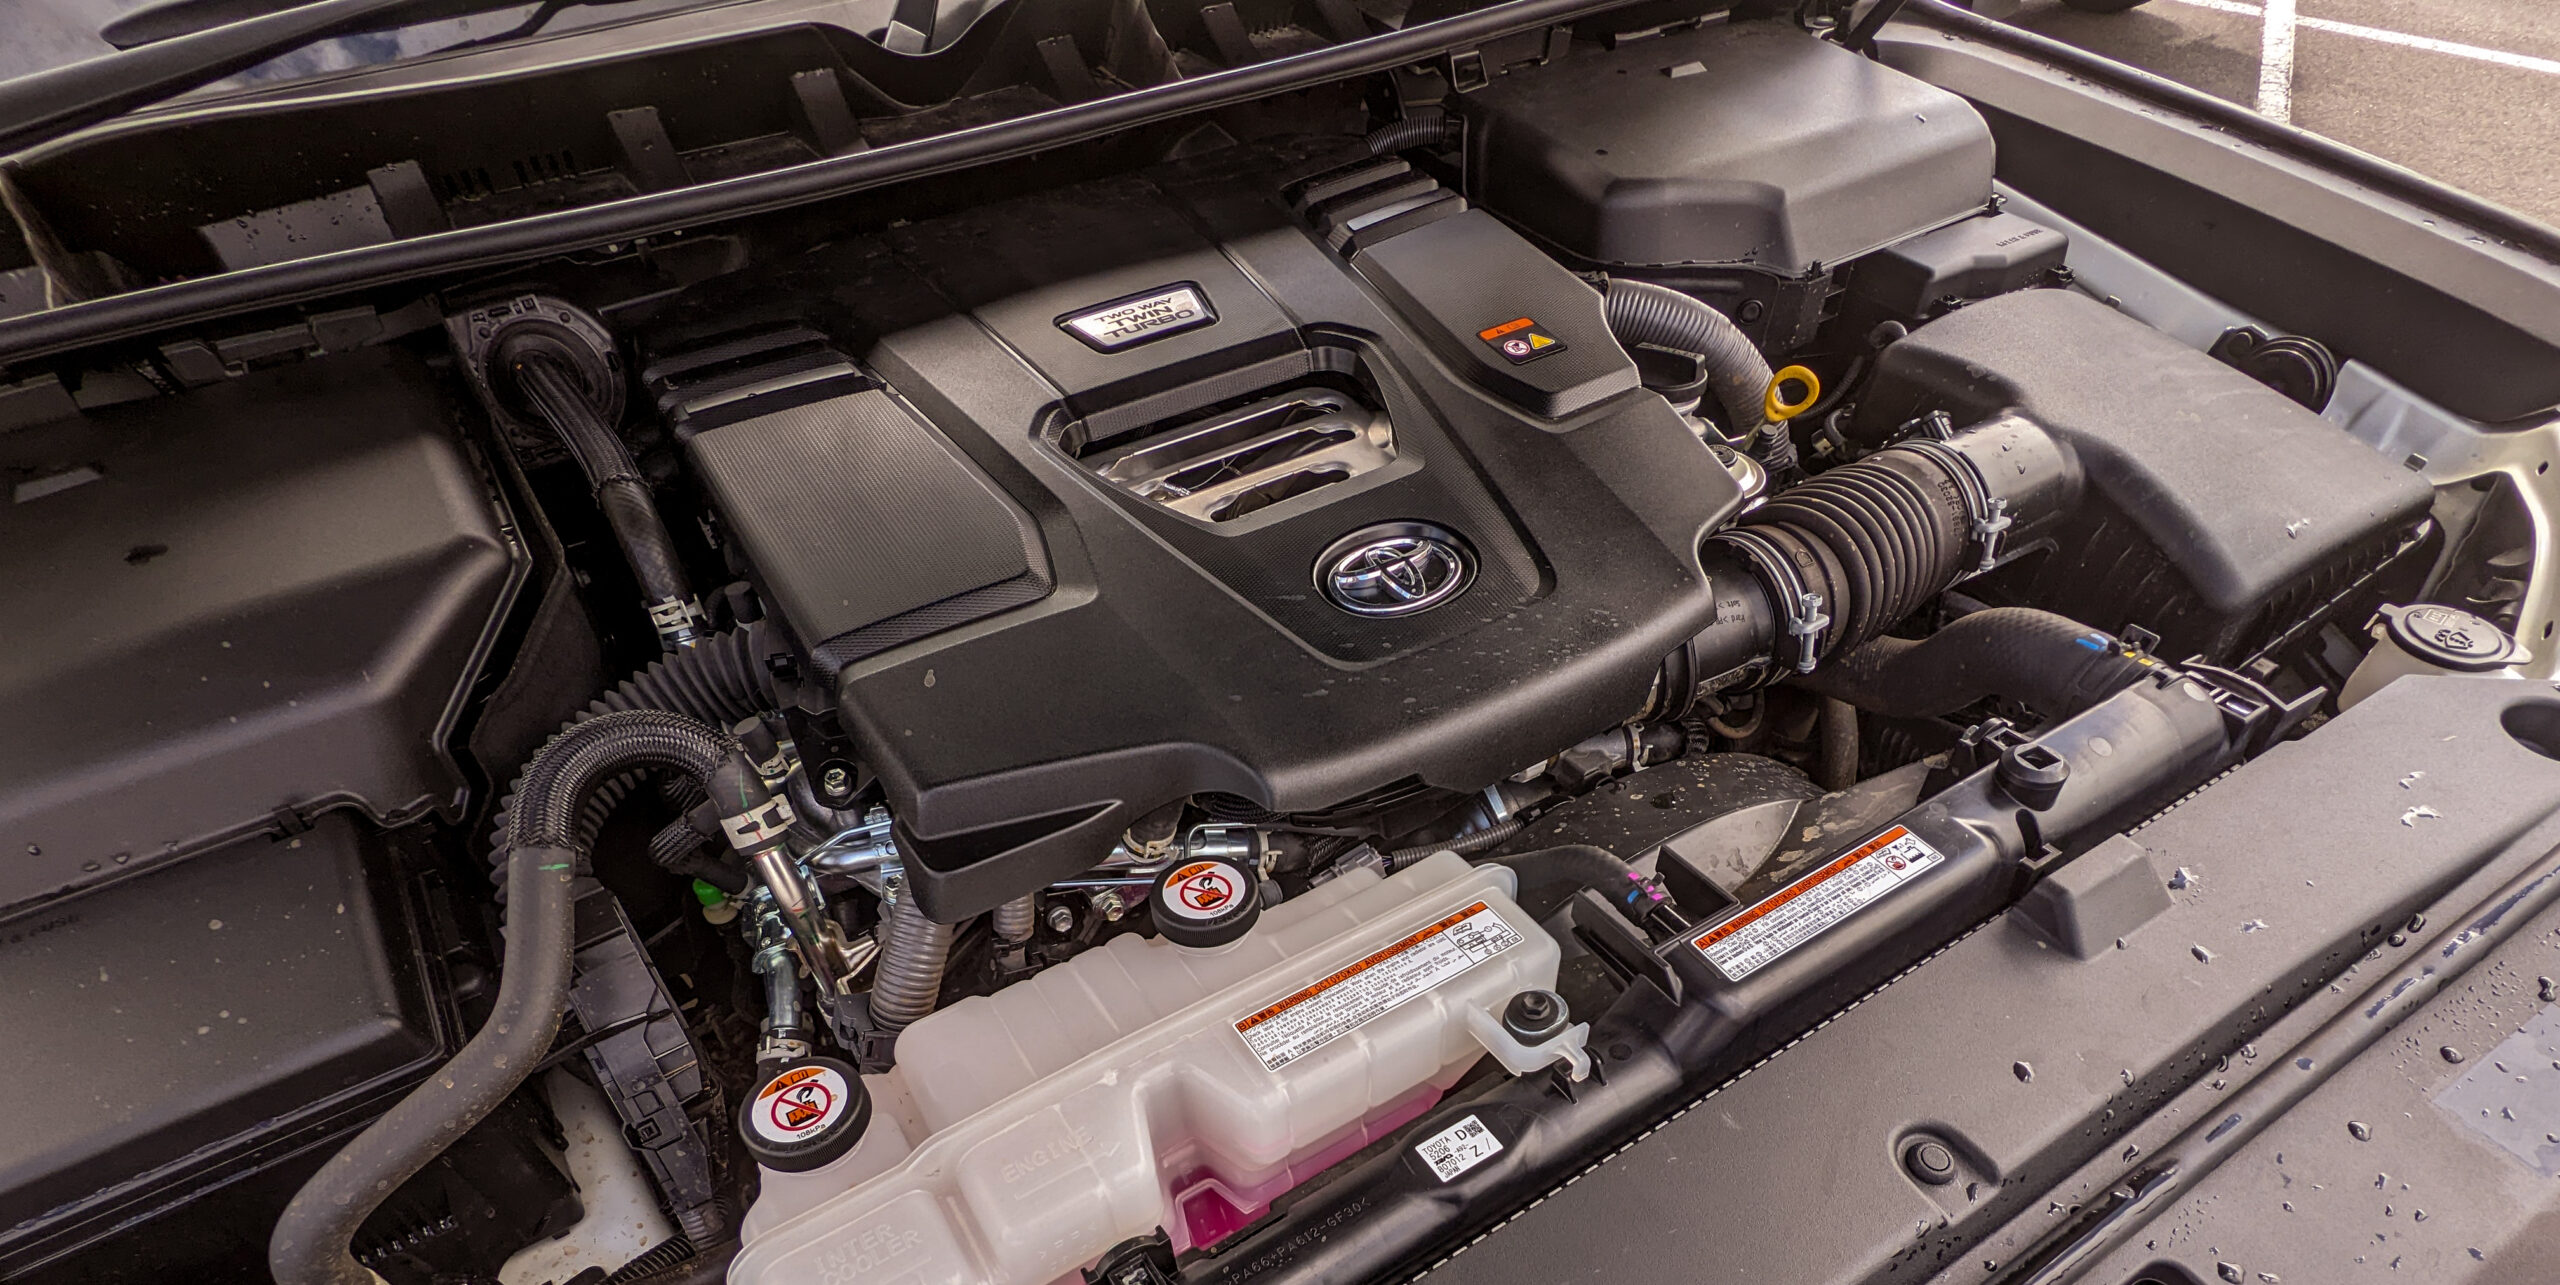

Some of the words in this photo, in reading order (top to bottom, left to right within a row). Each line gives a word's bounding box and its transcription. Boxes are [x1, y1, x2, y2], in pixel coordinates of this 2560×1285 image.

[1095, 308, 1136, 323] TWO
[1138, 297, 1173, 311] WAY
[1109, 306, 1174, 328] TWIN
[1104, 309, 1195, 338] TURBO
[1729, 910, 1759, 929] WARNING
[1795, 864, 1841, 891] AVERTISSEMENT
[1237, 1022, 1247, 1030] B
[1276, 988, 1313, 1010] WARNING
[1363, 935, 1420, 966] AVERTISSEMENT
[796, 1124, 827, 1139] 108kPa
[1454, 1129, 1467, 1141] D
[1000, 1126, 1095, 1183] ENGINE
[1422, 1136, 1452, 1155] TOYOTA
[1469, 1145, 1484, 1158] Z
[1444, 1165, 1461, 1178] JAPAN
[814, 1223, 895, 1275] INTER
[823, 1230, 923, 1285] COOLER
